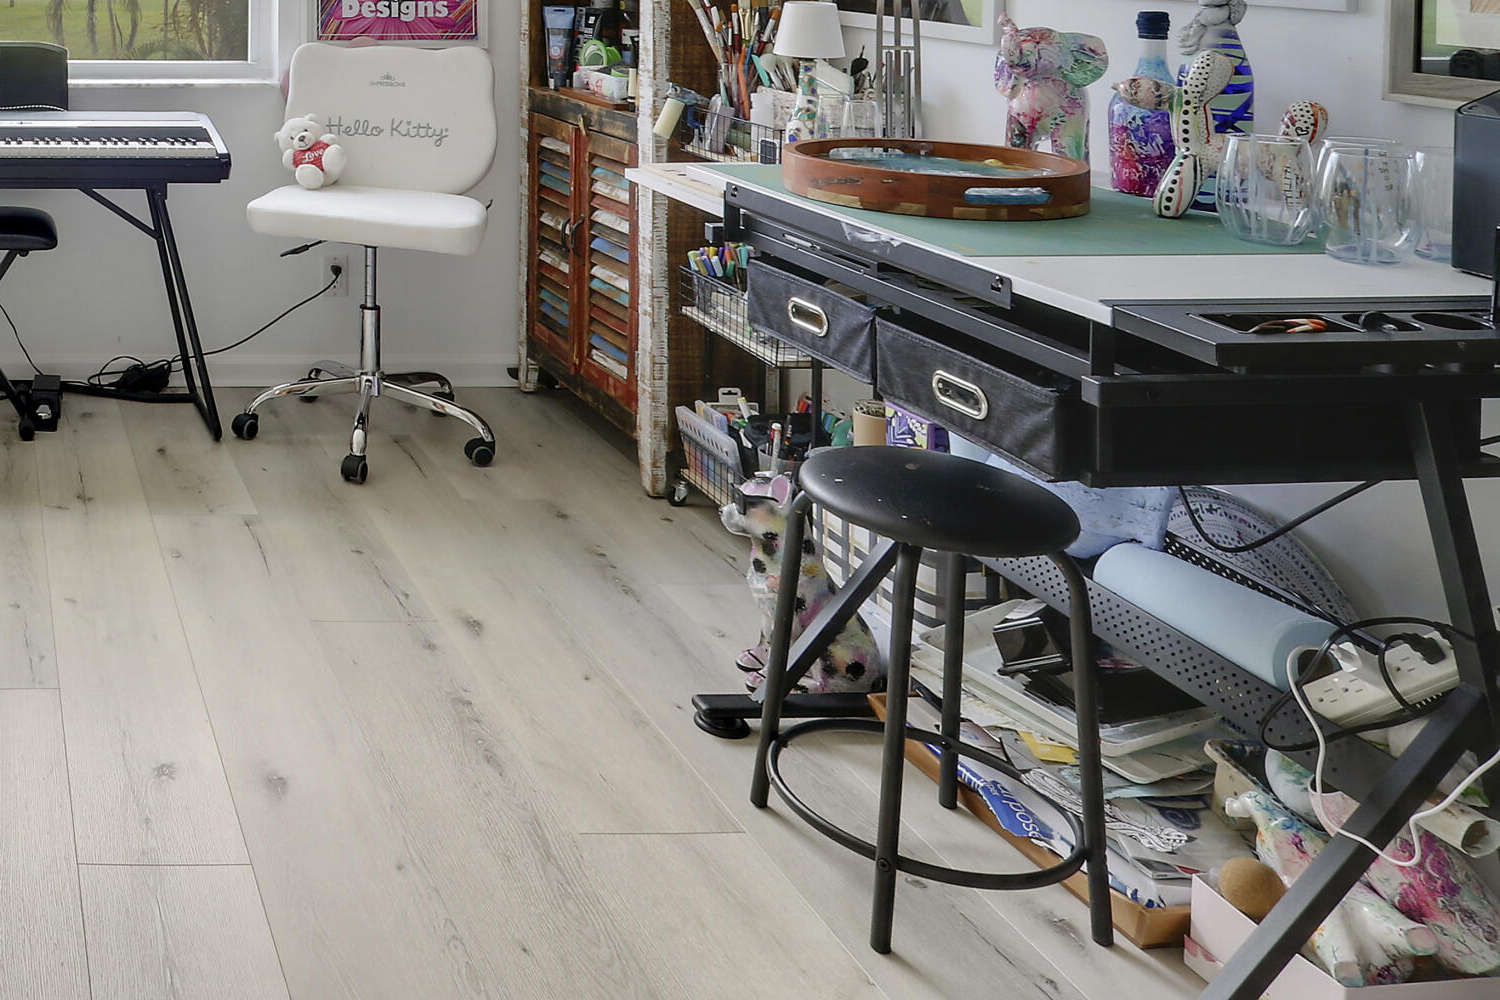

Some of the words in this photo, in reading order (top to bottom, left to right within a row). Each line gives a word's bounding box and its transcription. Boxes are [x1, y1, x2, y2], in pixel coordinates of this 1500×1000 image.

[325, 115, 385, 137] Hello
[390, 117, 449, 148] Kitty
[302, 149, 325, 163] Love
